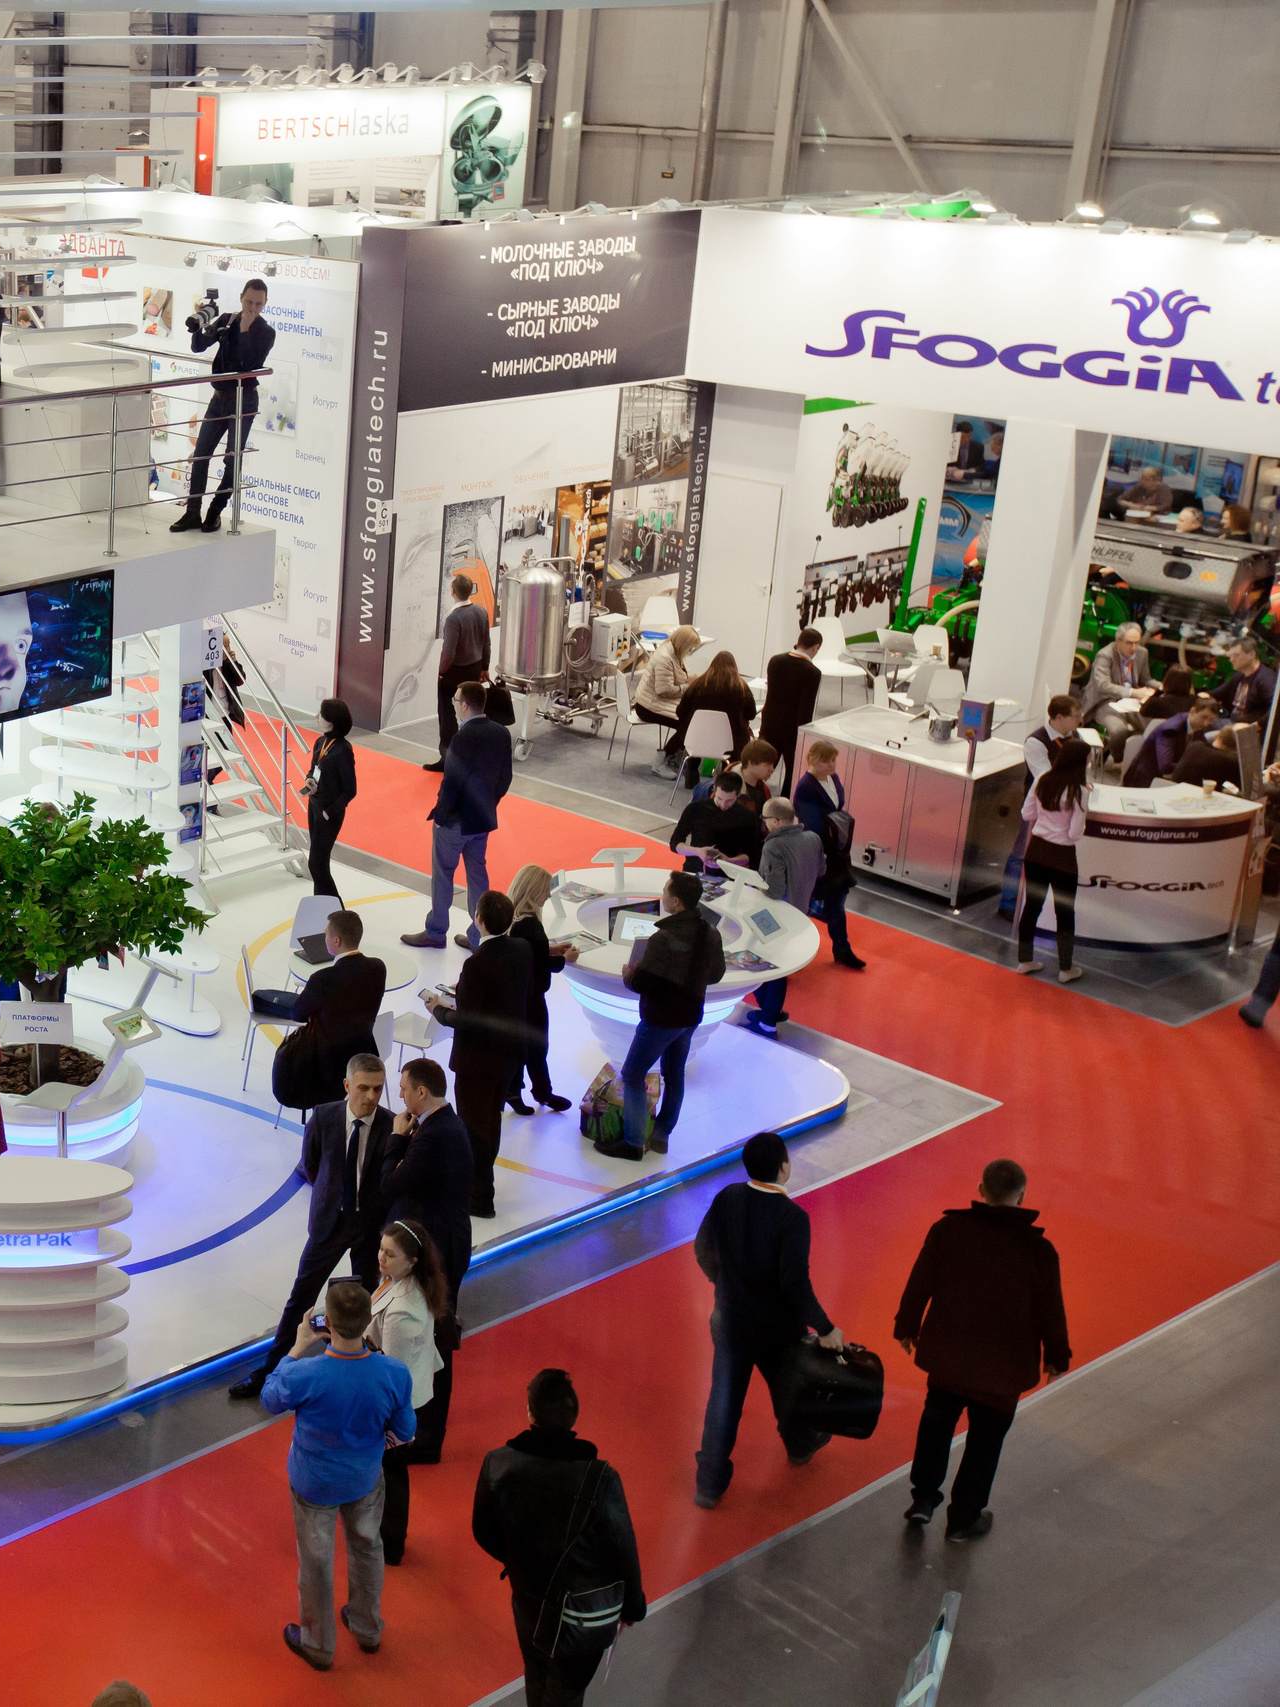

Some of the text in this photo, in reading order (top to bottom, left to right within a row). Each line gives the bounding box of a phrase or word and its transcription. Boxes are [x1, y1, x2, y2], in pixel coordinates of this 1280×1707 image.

[490, 240, 575, 264] МОЛОЧНЫЕ
[578, 236, 637, 257] ЗАВОДЫ
[285, 264, 299, 278] ВО
[300, 266, 331, 281] ВСЕМ!
[510, 258, 604, 282] «ПОД КЛЮЧ»
[261, 305, 305, 319] ВАСОЧНЫЕ
[497, 298, 559, 321] СЫРНЫЕ
[561, 293, 620, 315] ЗАВОДЫ
[277, 322, 322, 337] ФЕРМЕНТЫ
[506, 314, 599, 339] «ПОД КЛЮЧ»
[301, 348, 333, 362] Ряженка
[491, 348, 617, 378] МИНИСЫРОВАРНИ
[312, 394, 339, 411] Йогурт
[295, 449, 326, 465] Варенец
[514, 471, 551, 484] ОБУЧЕНИЕ
[293, 486, 321, 500] СМЕСИ
[358, 330, 388, 644] www.sfoggiatech.ru
[460, 480, 494, 493] МОНТАЖ
[245, 489, 289, 507] НА ОСНОВЕ
[230, 500, 305, 525] МЛОЧНОГО БЕЛКА
[381, 508, 388, 518] C
[682, 425, 708, 612] www.sfoggiatech.ru
[293, 535, 317, 551] Творог
[303, 587, 328, 603] Йогурт
[208, 637, 217, 650] C
[279, 633, 318, 653] Плавленый
[205, 650, 220, 661] 403
[291, 647, 305, 659] сыр
[1100, 825, 1199, 840] www.sfoggiarus.ru
[11, 1013, 60, 1023] ПЛАТФОРМЫ
[24, 1025, 49, 1033] РОСТА
[36, 1233, 73, 1247] Pak
